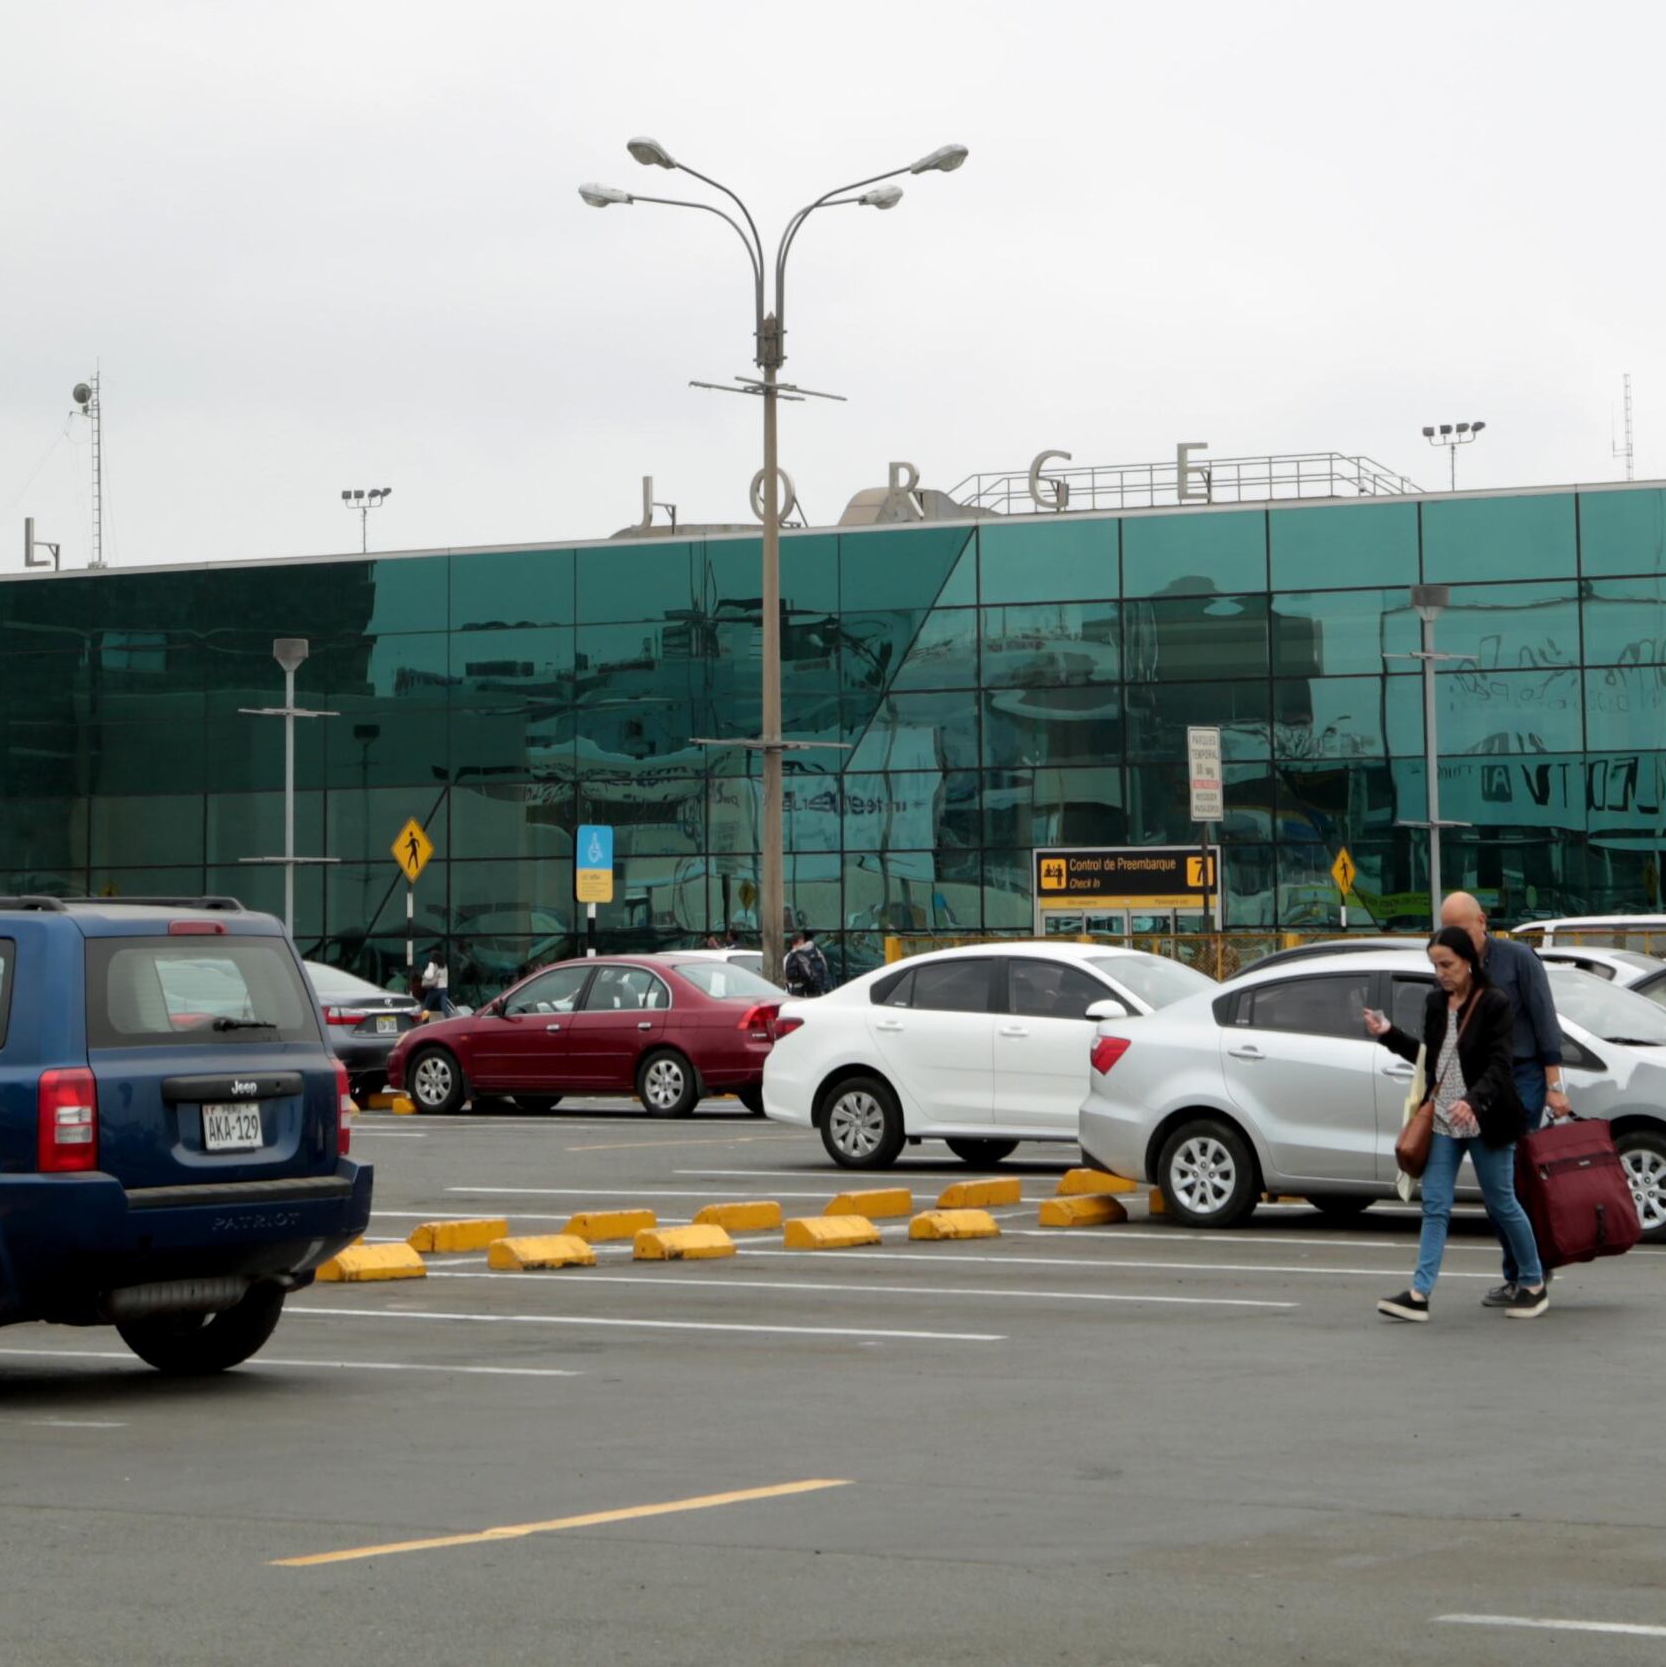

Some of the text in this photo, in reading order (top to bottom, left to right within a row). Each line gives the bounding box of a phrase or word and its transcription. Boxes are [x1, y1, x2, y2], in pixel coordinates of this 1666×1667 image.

[637, 441, 1209, 531] JORGE
[1069, 857, 1177, 873] Control de Preembarque
[1069, 877, 1101, 889] Check In
[231, 1079, 257, 1096] Jeep
[208, 1114, 260, 1142] AKA-129
[212, 1212, 300, 1231] PATRIOT
